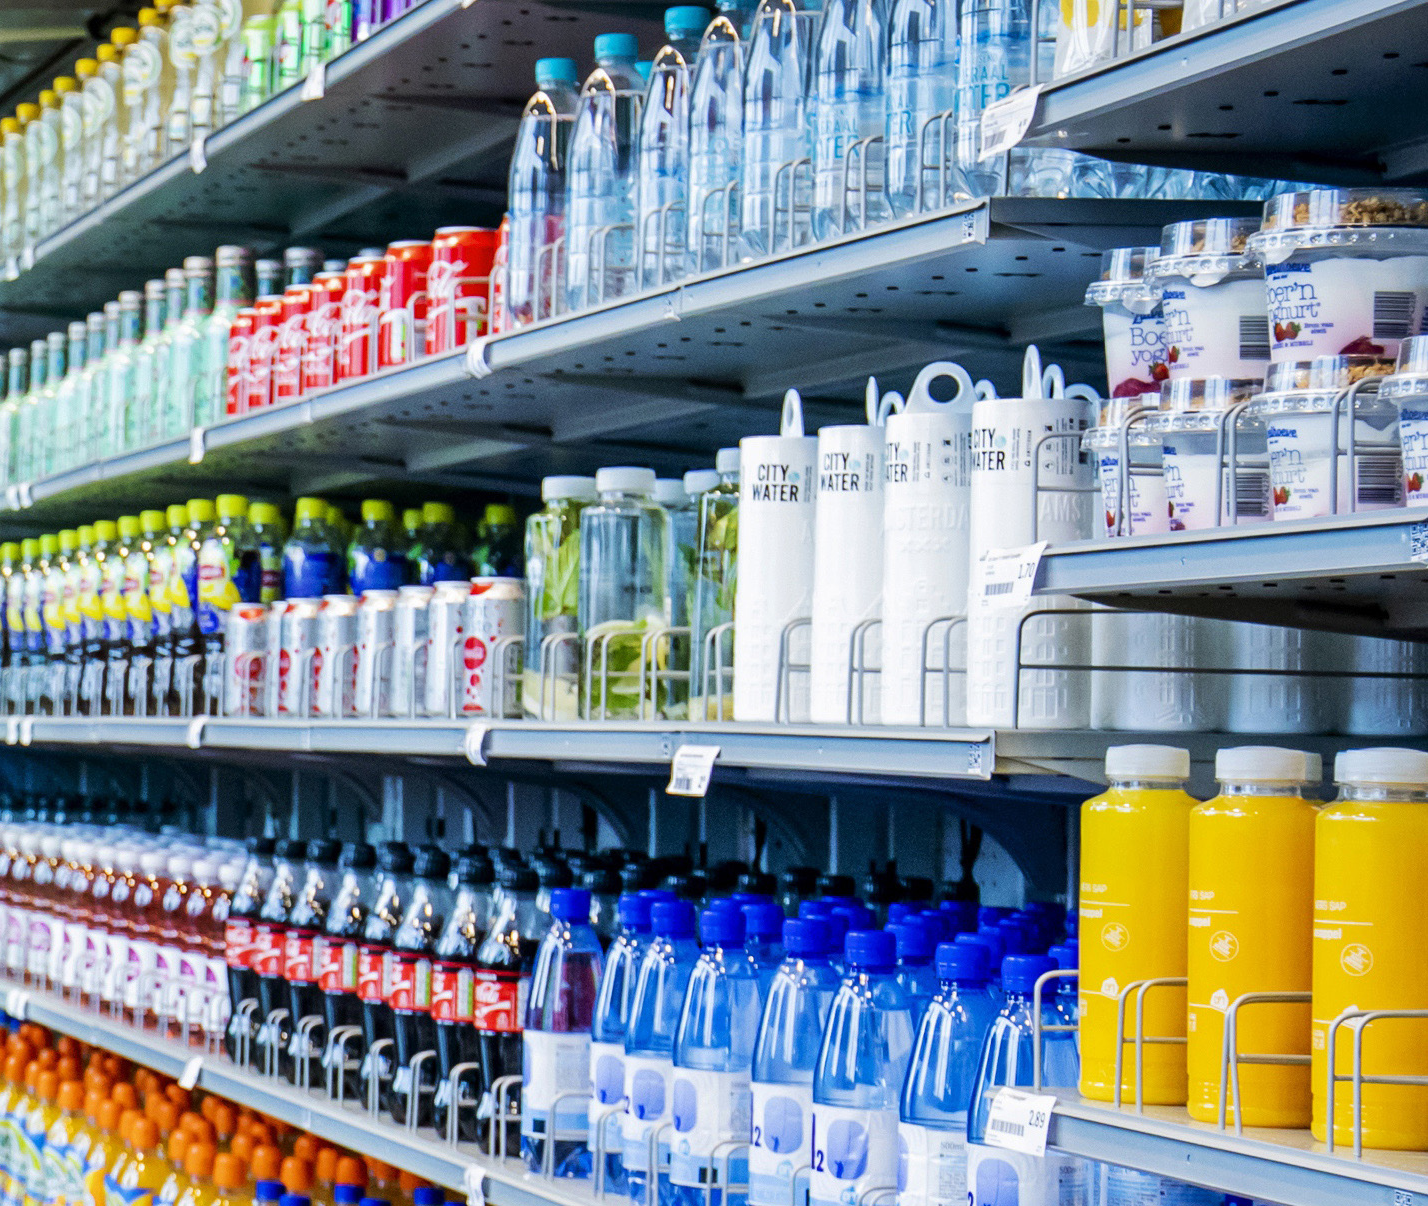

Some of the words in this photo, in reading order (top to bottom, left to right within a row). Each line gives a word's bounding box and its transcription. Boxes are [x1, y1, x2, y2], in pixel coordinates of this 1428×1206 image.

[886, 442, 900, 461] ITY
[824, 453, 850, 471] CITY
[758, 465, 789, 481] CITY
[820, 473, 859, 491] WATER
[752, 484, 799, 502] WATER
[1028, 1109, 1046, 1129] 2.89
